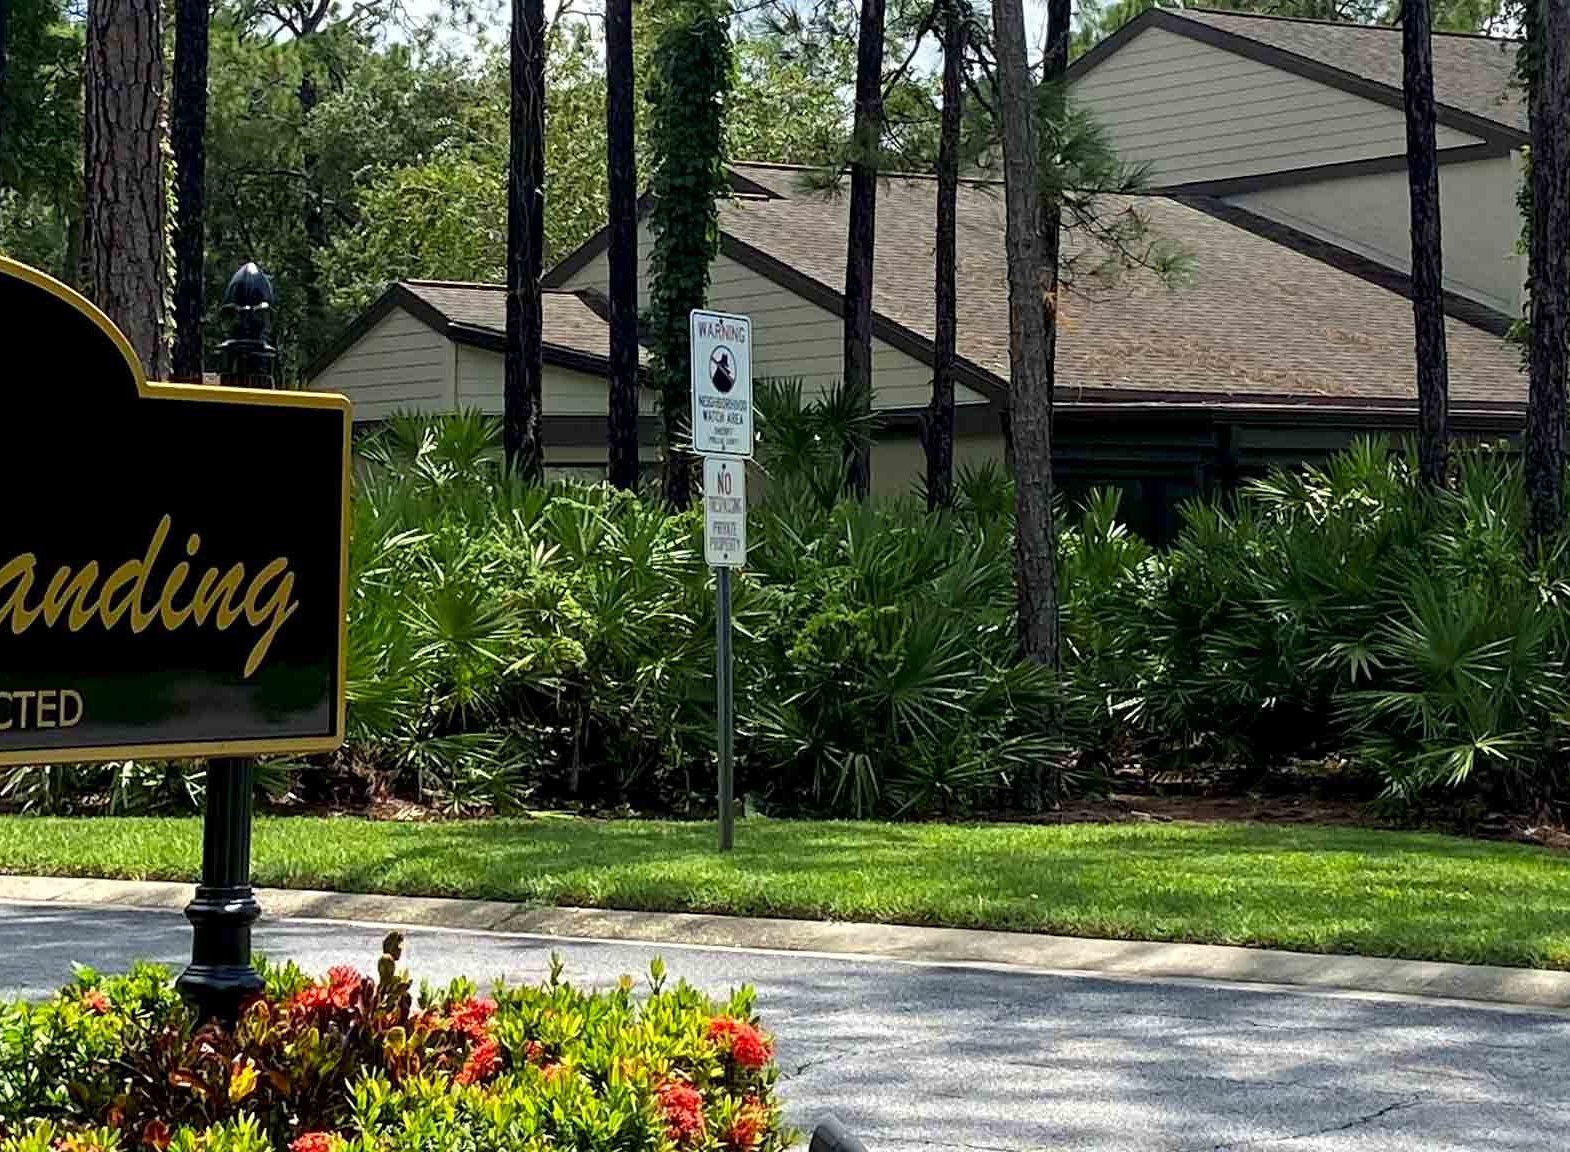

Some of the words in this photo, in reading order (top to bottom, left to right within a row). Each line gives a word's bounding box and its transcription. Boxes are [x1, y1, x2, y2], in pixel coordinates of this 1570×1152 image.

[698, 321, 745, 344] WARNING
[702, 409, 724, 423] WATCH
[727, 412, 743, 425] AREA
[718, 472, 732, 495] NO
